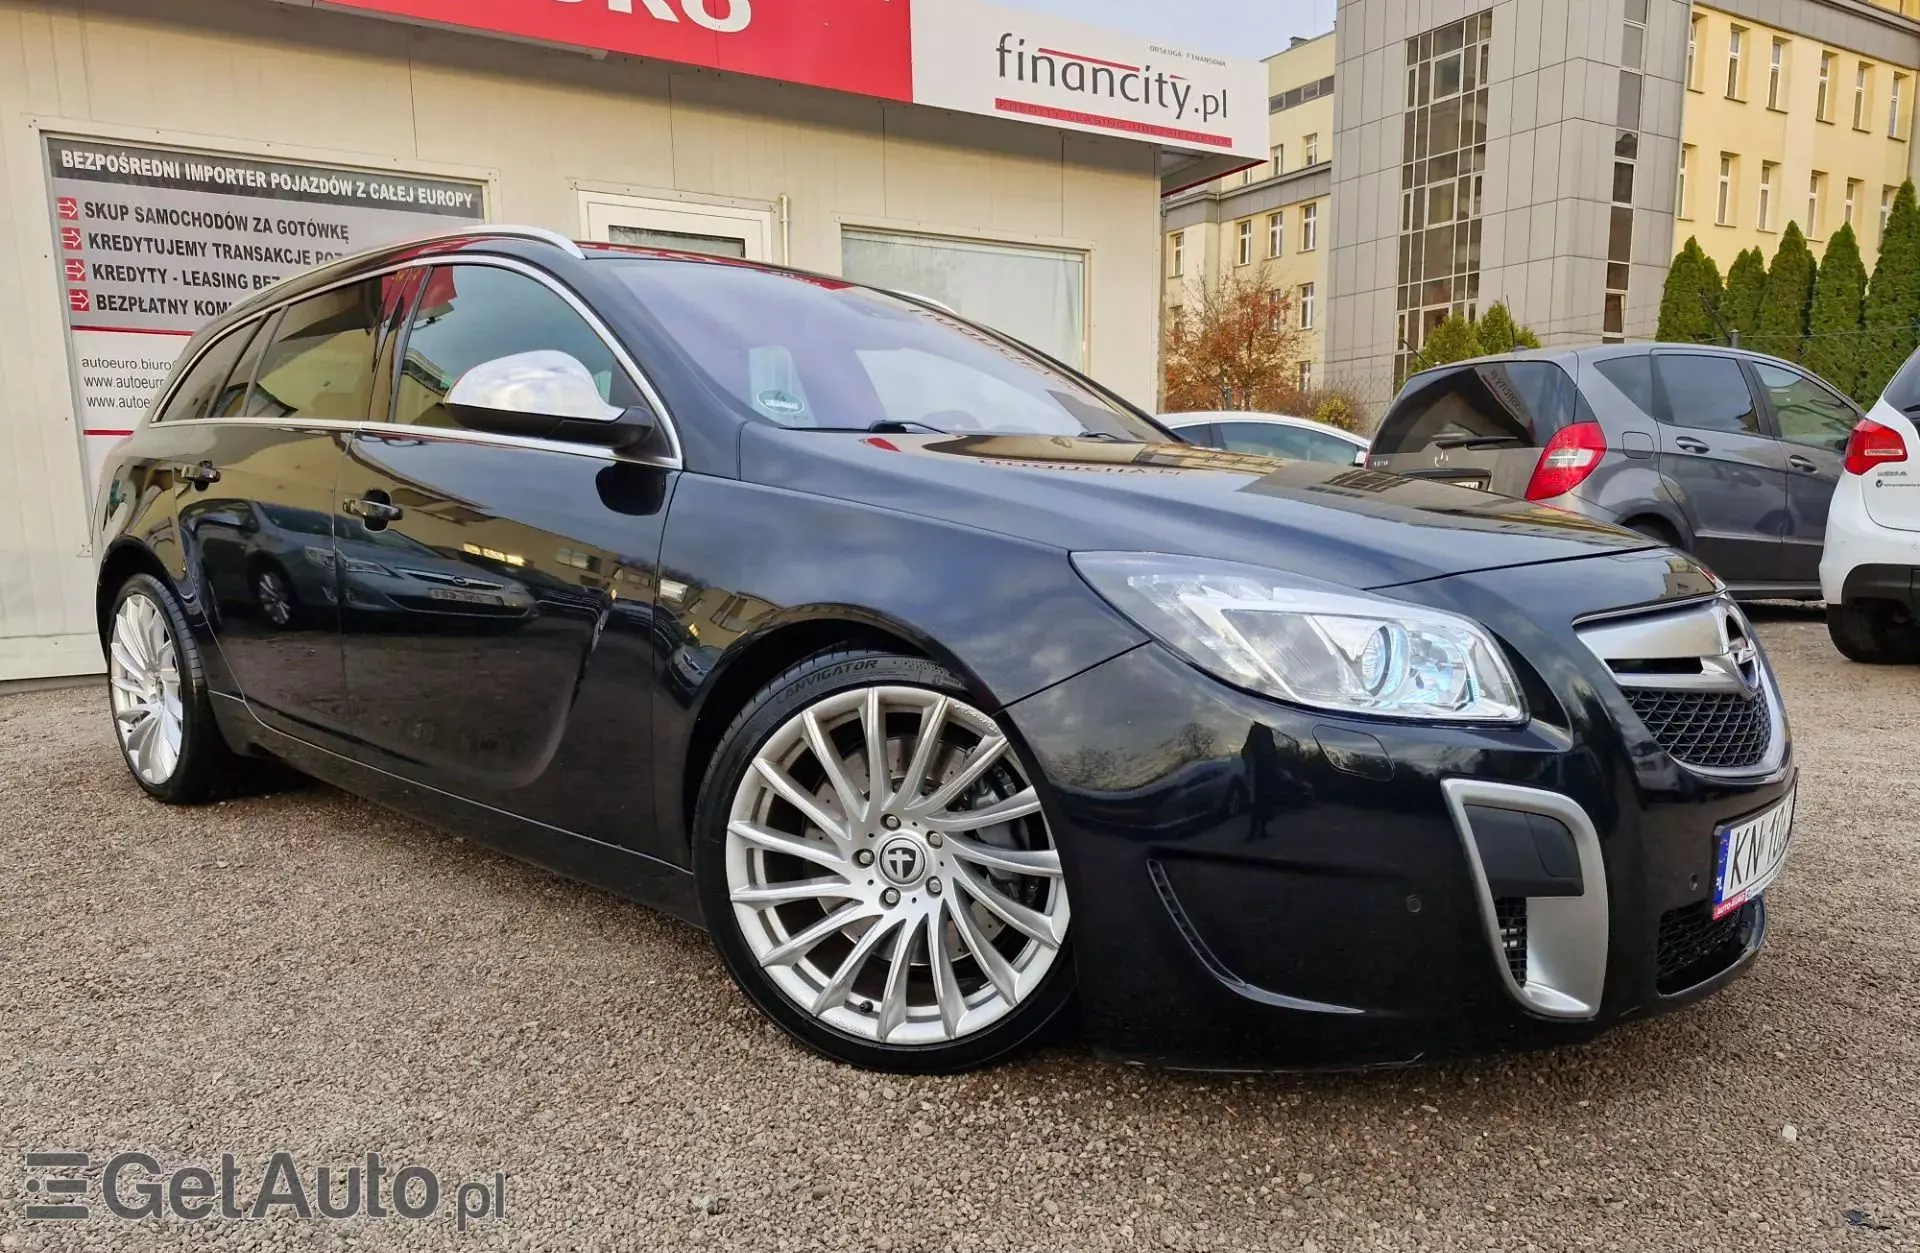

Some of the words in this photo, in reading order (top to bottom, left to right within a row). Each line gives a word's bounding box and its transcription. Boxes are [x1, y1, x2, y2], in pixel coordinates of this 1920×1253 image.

[995, 32, 1228, 123] financity.pl
[61, 150, 181, 179] BEZPOŚREDNI
[185, 163, 268, 188] IMPORTER
[271, 173, 352, 197] POJAZDÓW
[356, 181, 367, 198] Z
[369, 183, 414, 203] CAŁEJ
[418, 188, 473, 209] EUROPY
[85, 201, 129, 220] SKUP
[135, 206, 248, 232] SAMOCHODÓW
[253, 217, 272, 233] ZA
[277, 218, 349, 244] GOTÓWKĘ
[88, 232, 207, 257] KREDYTUJEMY
[212, 243, 312, 265] TRANSAKCJE
[92, 263, 168, 283] KREDYTY
[182, 270, 249, 289] LEASING
[96, 295, 188, 314] BEZPŁATNY
[194, 300, 232, 316] KOM
[86, 394, 152, 409] www.autoe
[1729, 820, 1765, 890] KN
